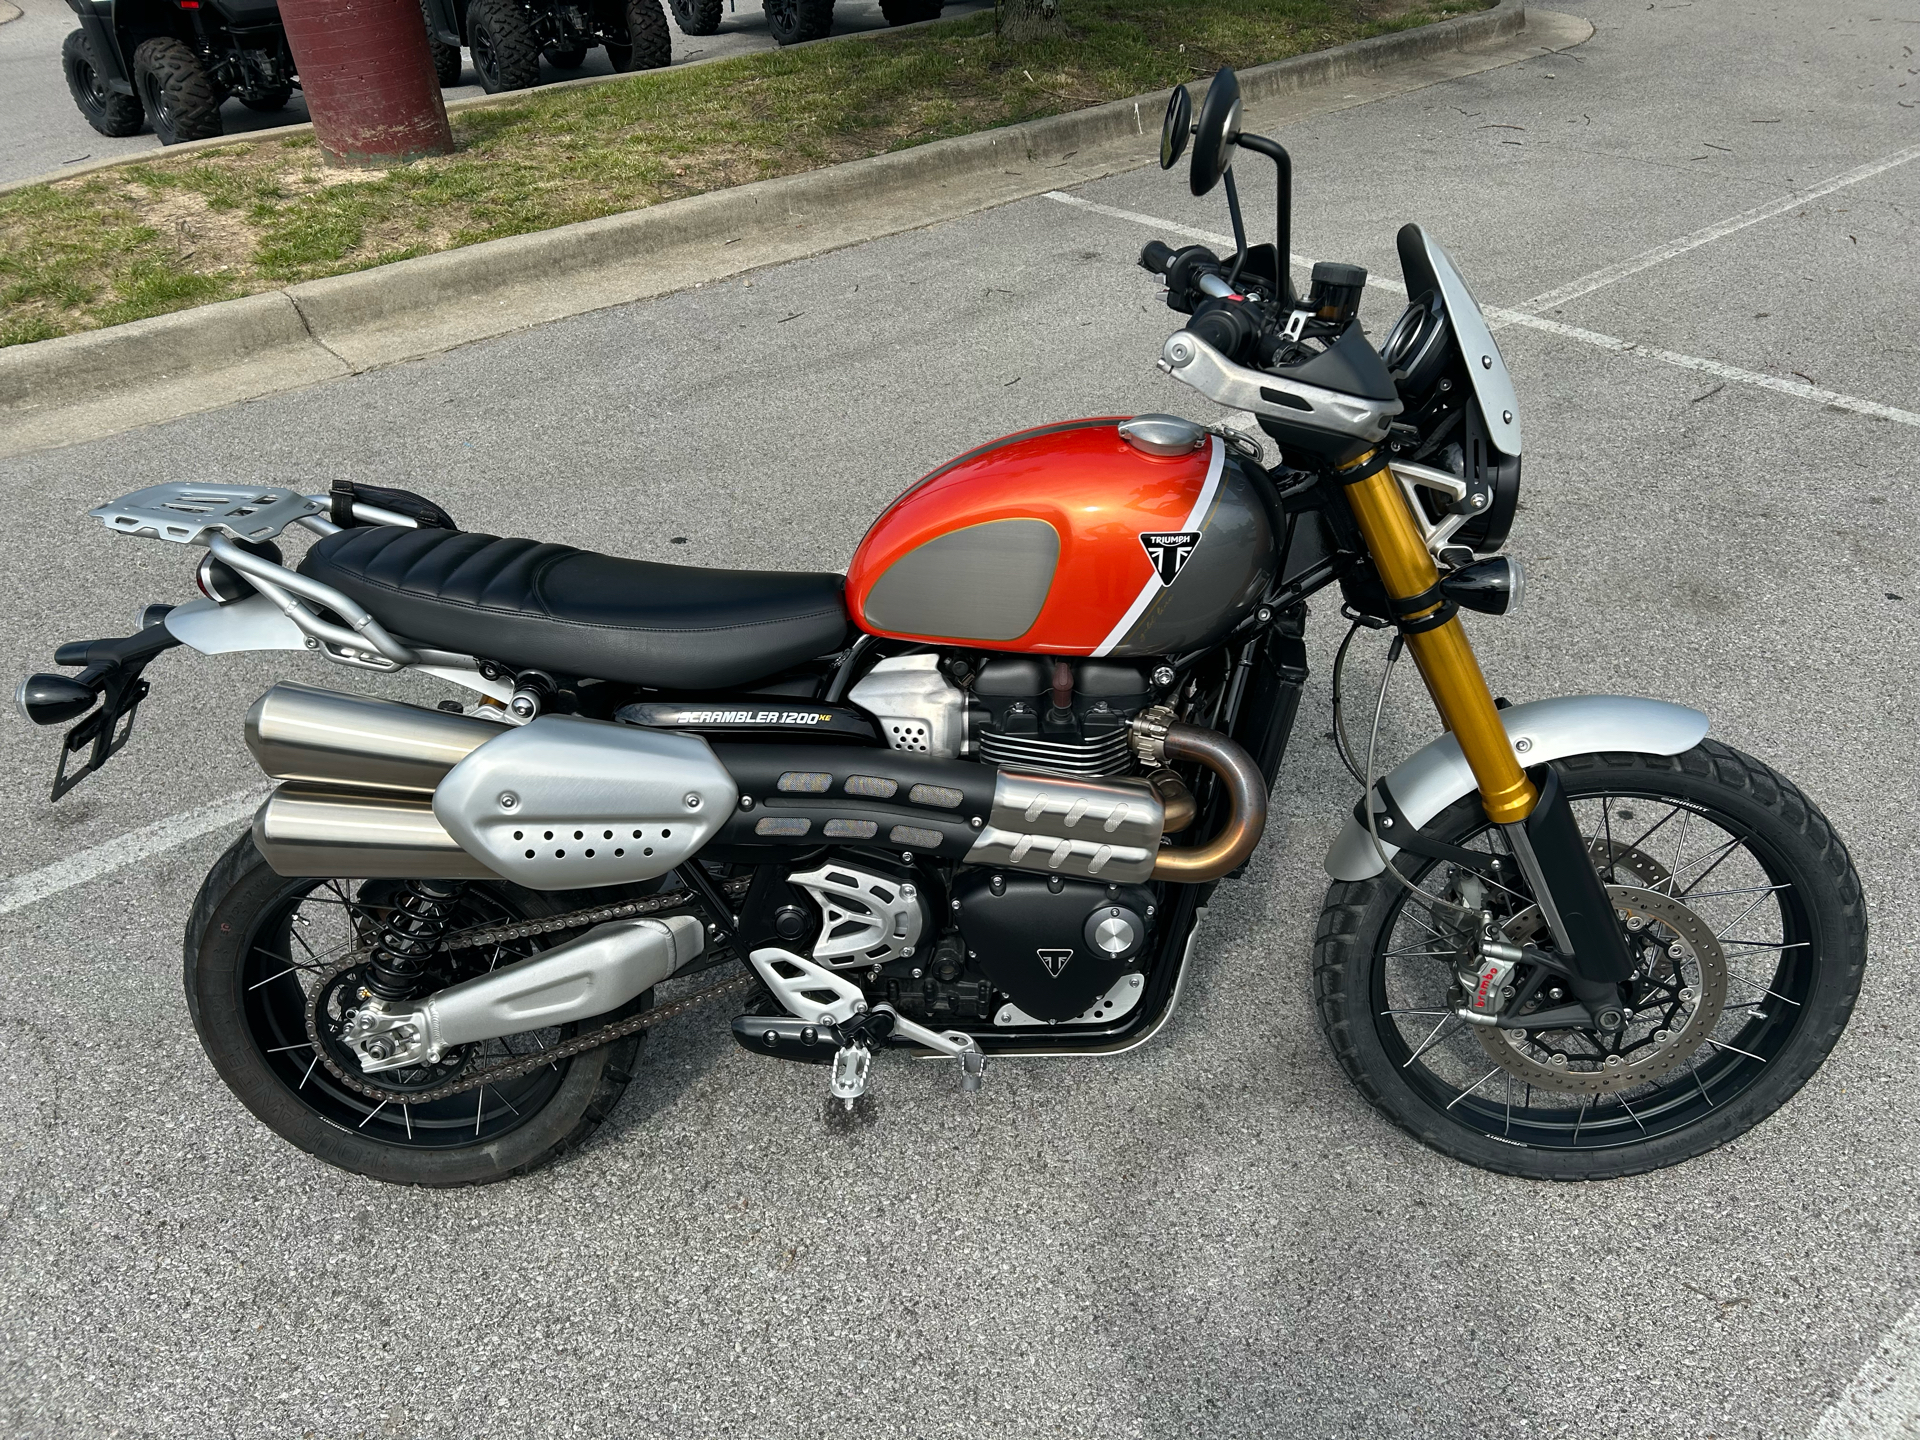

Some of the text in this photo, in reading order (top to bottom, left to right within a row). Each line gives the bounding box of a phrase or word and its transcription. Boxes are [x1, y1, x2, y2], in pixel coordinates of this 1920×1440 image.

[1150, 535, 1191, 547] TRIUMPH
[678, 711, 832, 725] SCRAMBLER 1200 XE
[1474, 967, 1498, 1008] brembo
